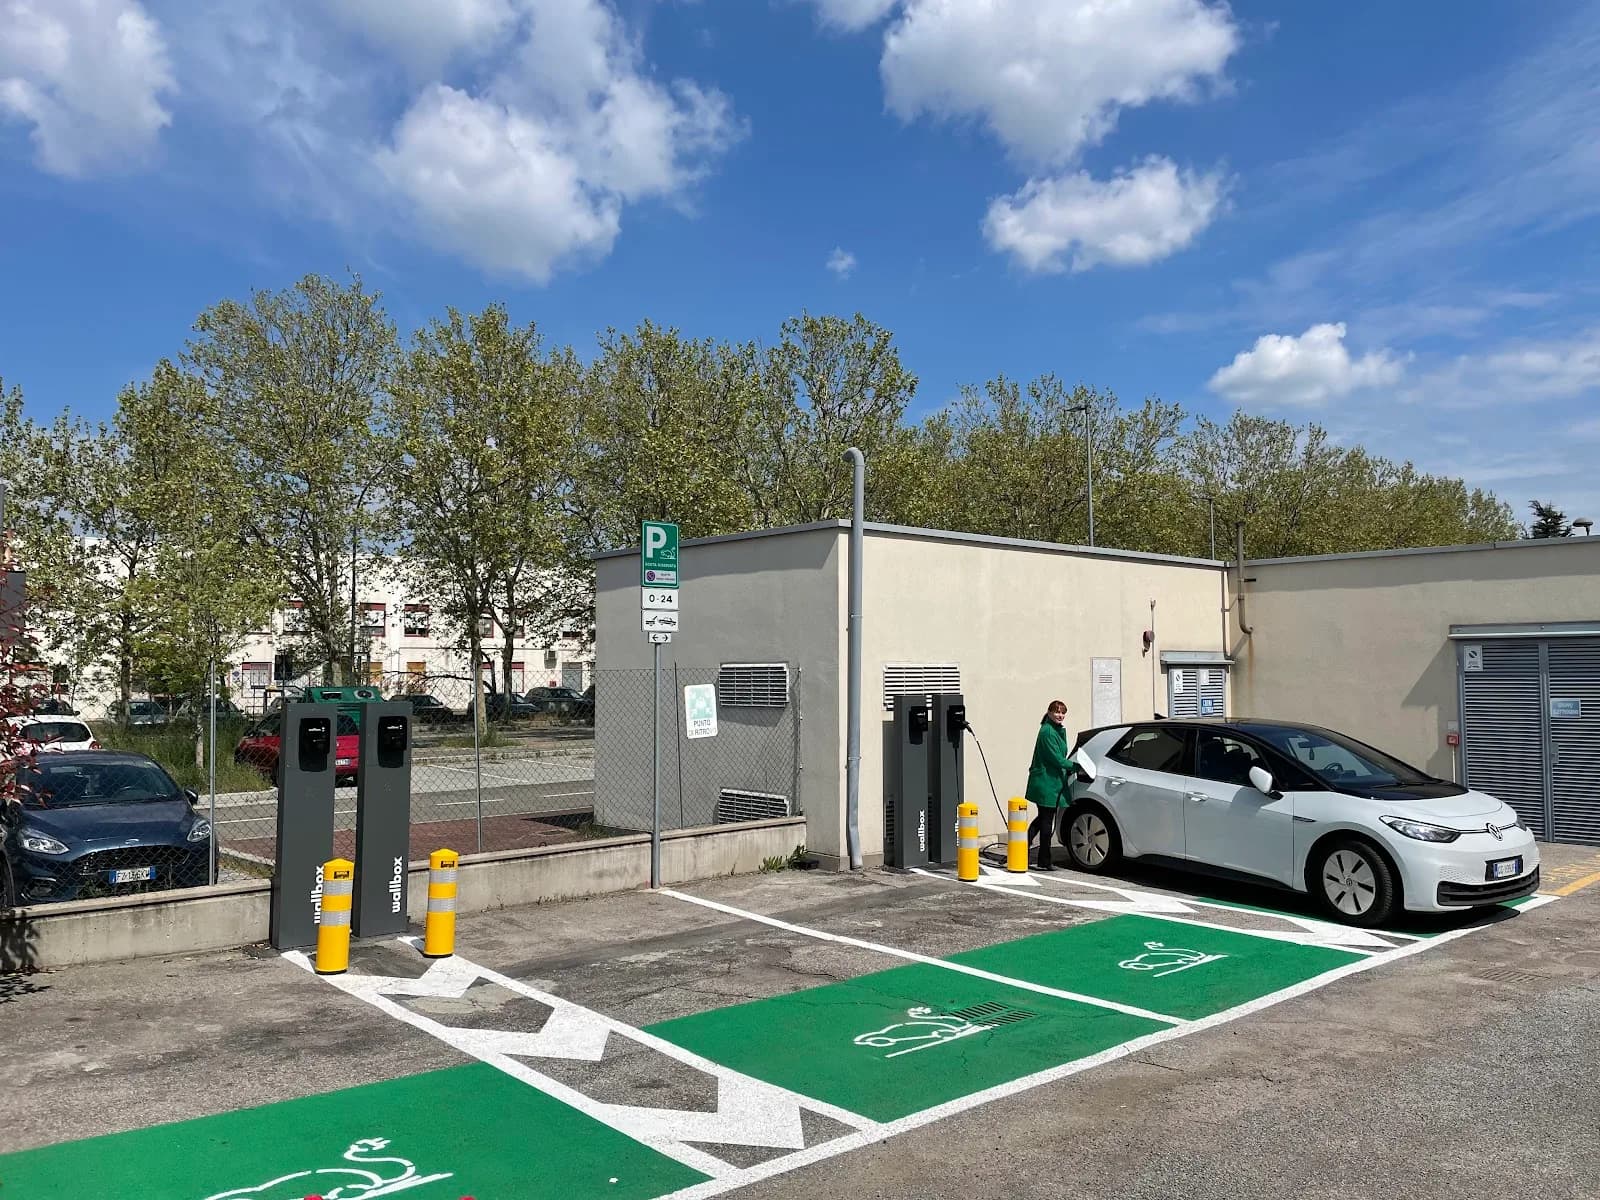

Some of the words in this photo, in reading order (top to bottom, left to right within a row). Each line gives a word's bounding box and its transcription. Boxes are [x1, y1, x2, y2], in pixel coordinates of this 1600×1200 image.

[646, 526, 667, 558] P
[917, 809, 925, 851] wallbox
[389, 856, 402, 913] wallbox
